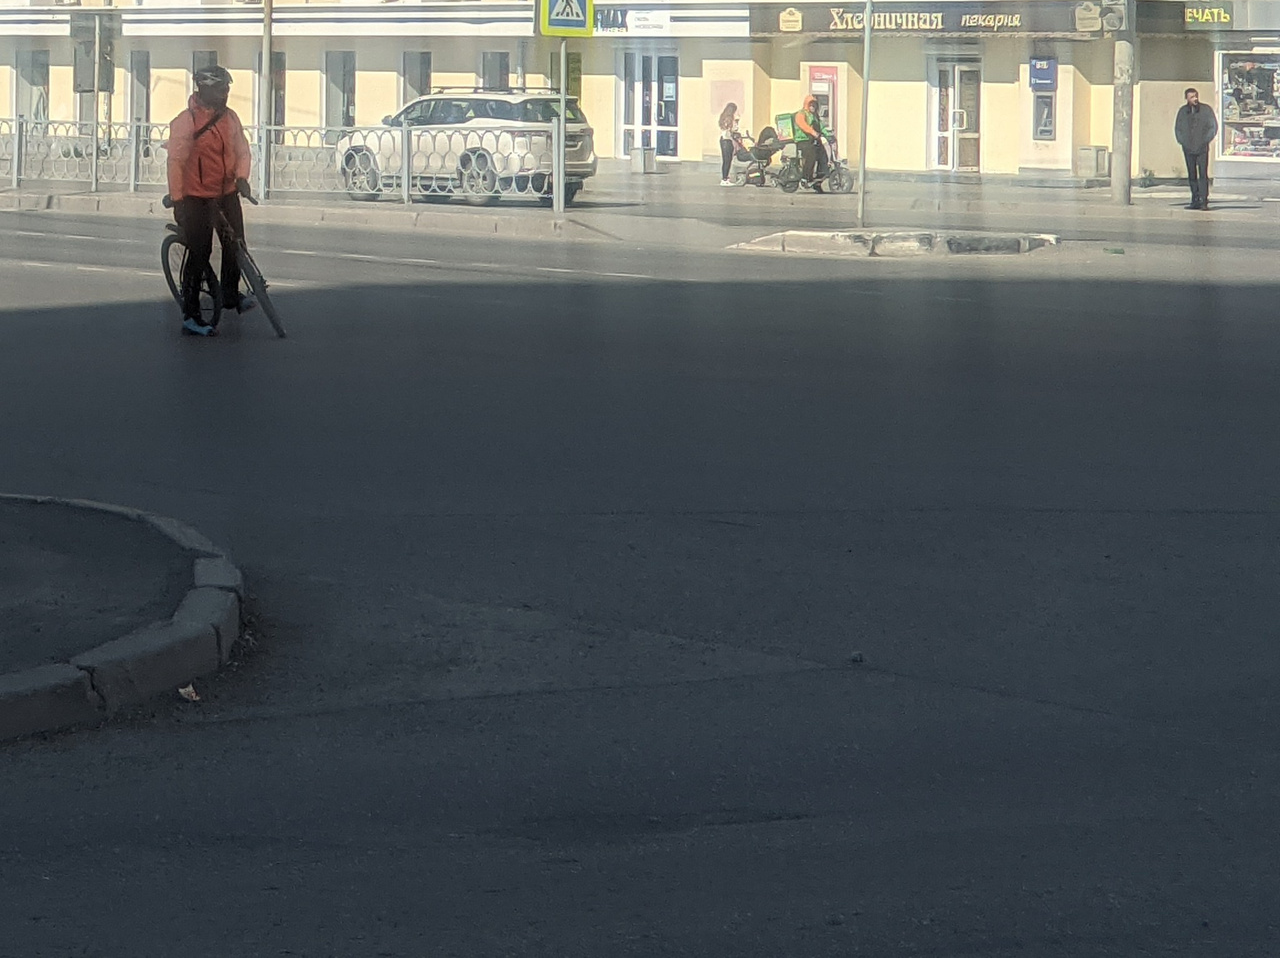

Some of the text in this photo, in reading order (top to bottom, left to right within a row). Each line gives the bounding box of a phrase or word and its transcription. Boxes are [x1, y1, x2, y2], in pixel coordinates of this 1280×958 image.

[829, 7, 1022, 32] Хленичная пекарня
[1184, 8, 1231, 23] ЕЧАТЬ
